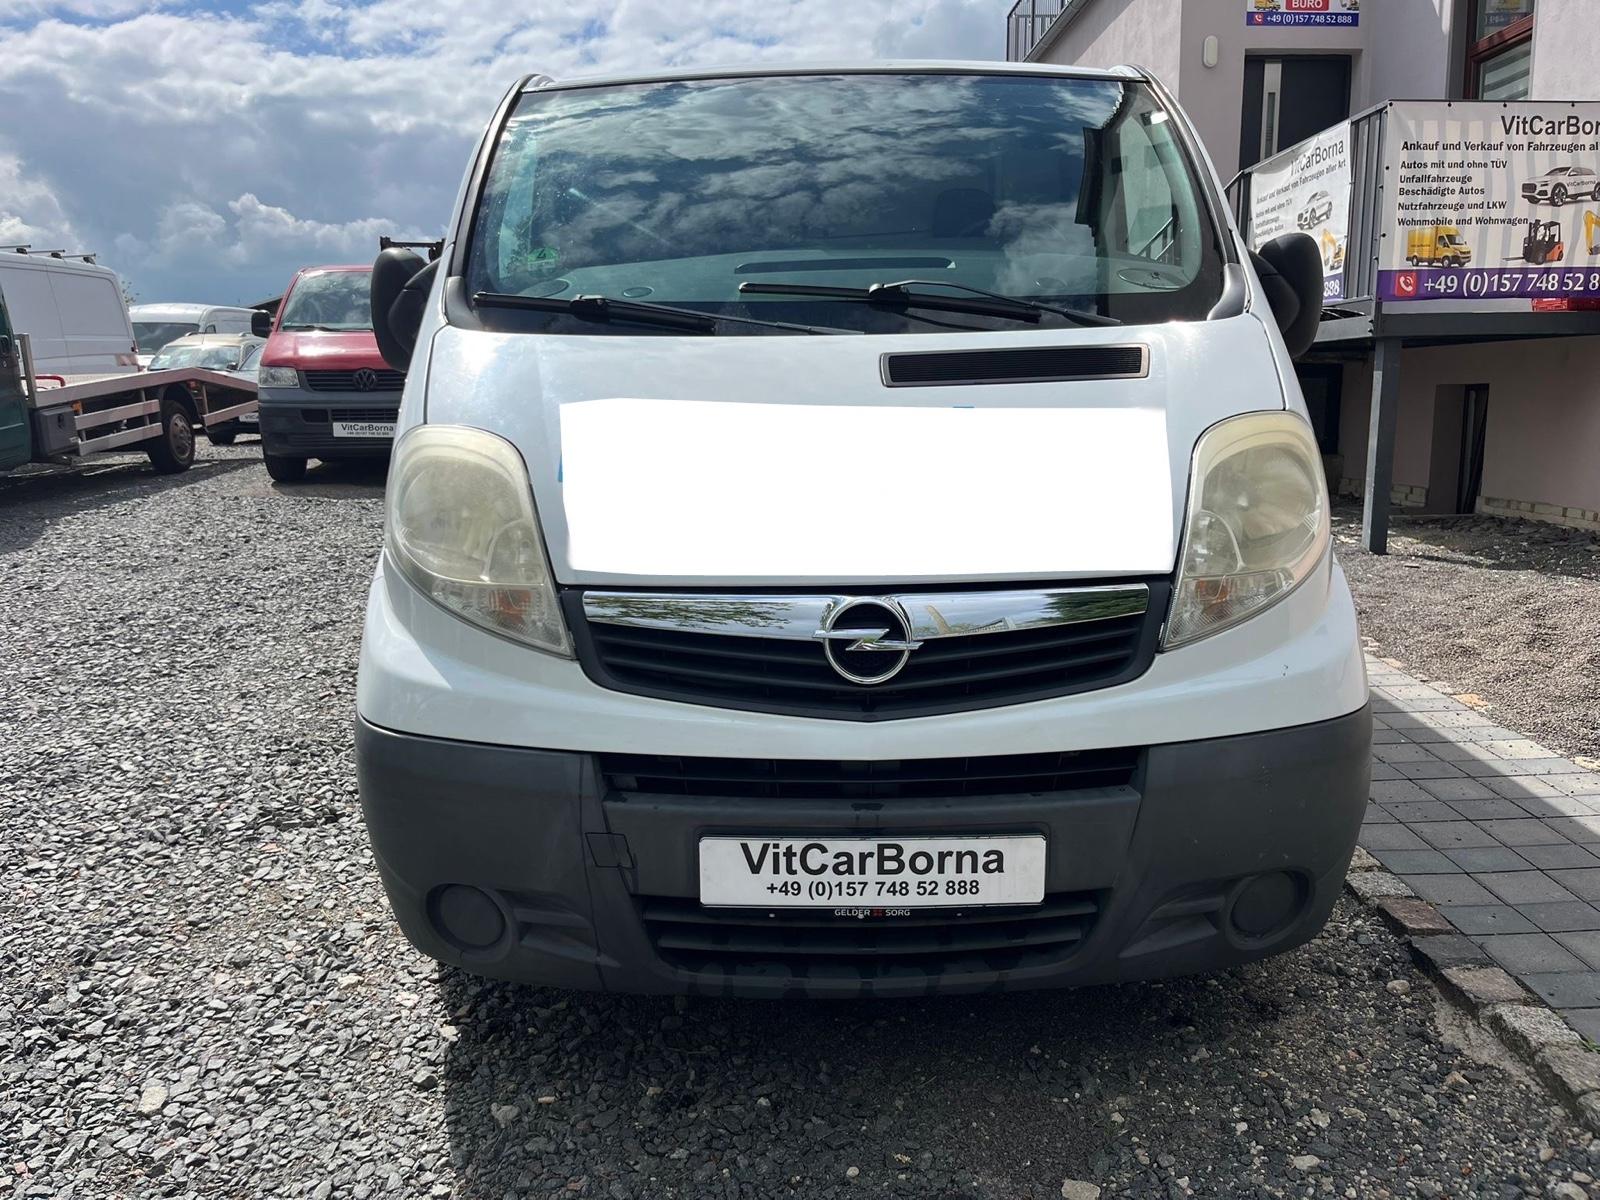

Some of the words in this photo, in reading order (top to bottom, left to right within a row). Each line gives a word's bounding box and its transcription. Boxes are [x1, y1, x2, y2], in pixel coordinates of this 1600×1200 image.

[1266, 15, 1281, 23] +49
[1282, 14, 1309, 24] (0)157
[1310, 15, 1325, 23] 748
[1326, 15, 1336, 23] 52
[1337, 15, 1352, 23] 888
[1401, 141, 1440, 151] Ankauf
[1442, 141, 1461, 151] und
[1464, 141, 1504, 151] Verkauf
[1506, 143, 1525, 151] von
[1527, 141, 1586, 153] Fahrzeugen
[1400, 160, 1428, 169] Autos
[1430, 160, 1445, 169] mit
[1447, 160, 1464, 169] und
[1466, 160, 1489, 169] ohne
[1490, 158, 1508, 169] TÜV
[1399, 174, 1473, 185] Unfallfahrzeuge
[1399, 186, 1456, 197] Beschädigte
[1458, 186, 1485, 195] Autos
[1398, 201, 1465, 212] Nutzfahrzeuge
[1467, 201, 1485, 210] und
[1486, 200, 1508, 210] LKW
[1397, 217, 1453, 226] Wohnmobile
[1455, 216, 1473, 226] und
[1475, 216, 1529, 227] Wohnwagen
[1424, 275, 1458, 293] +49
[1462, 271, 1523, 297] (0)157
[1526, 273, 1560, 291] 748
[1562, 273, 1585, 291] 52
[341, 423, 394, 432] VitCarBorna
[740, 842, 1005, 876] VitCarBorna
[766, 880, 802, 896] +49
[808, 880, 869, 900] (0)157
[875, 880, 910, 896] 748
[916, 880, 939, 896] 52
[945, 879, 980, 896] 888
[834, 908, 870, 917] GELDER
[885, 908, 911, 917] SORG
